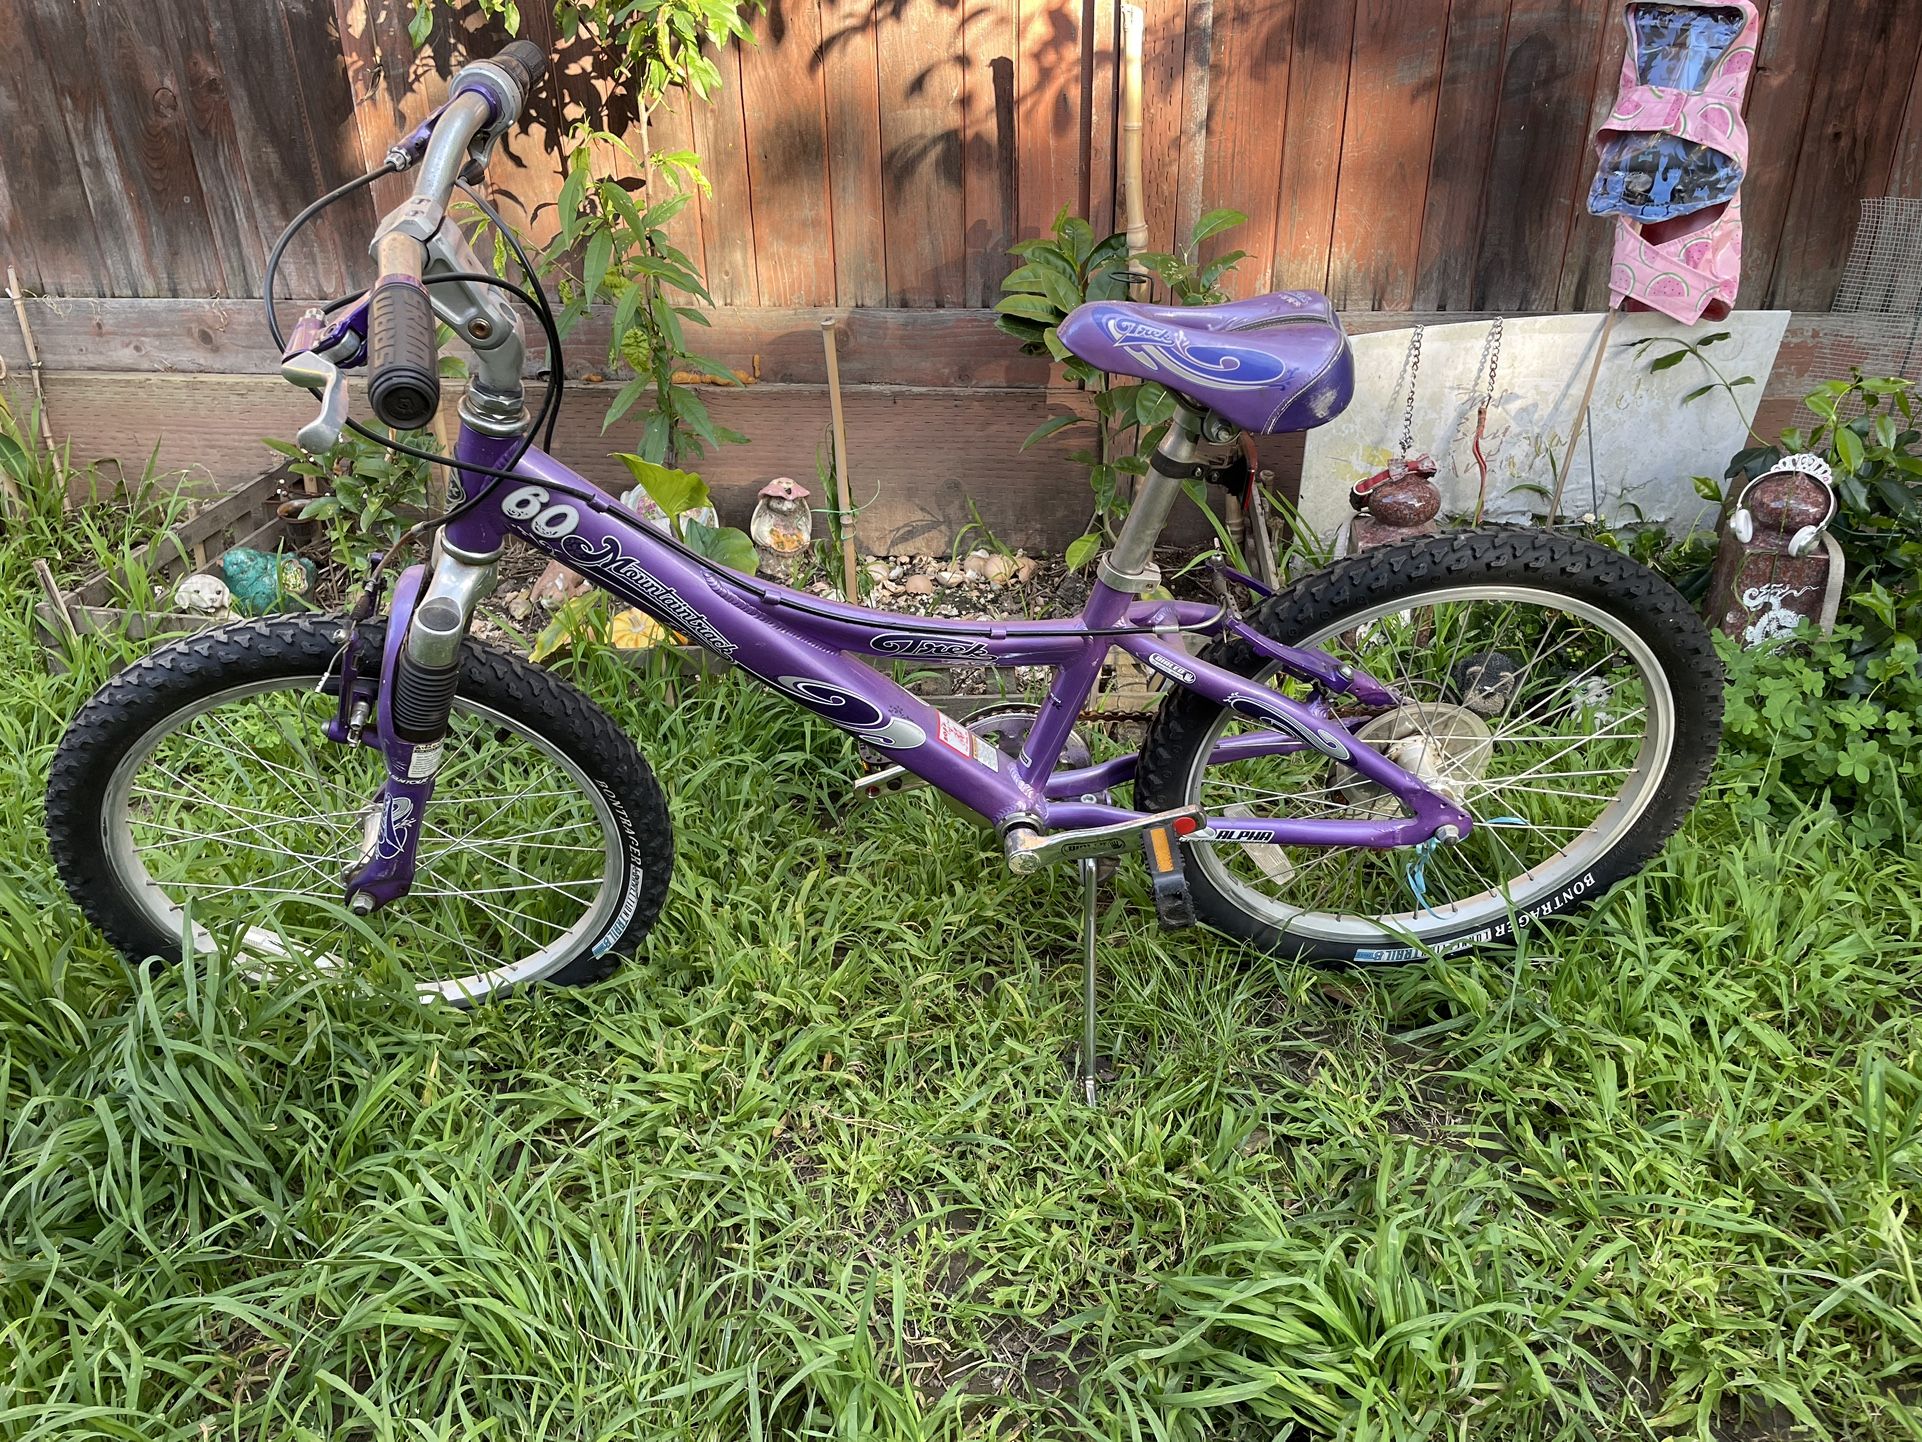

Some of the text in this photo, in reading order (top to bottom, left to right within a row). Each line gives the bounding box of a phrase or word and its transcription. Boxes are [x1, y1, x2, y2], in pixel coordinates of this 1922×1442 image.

[1114, 317, 1175, 346] Trek
[501, 486, 580, 538] 60
[870, 633, 992, 661] Trek
[596, 779, 641, 866] BONTRAGER
[1215, 830, 1273, 841] ALPHA
